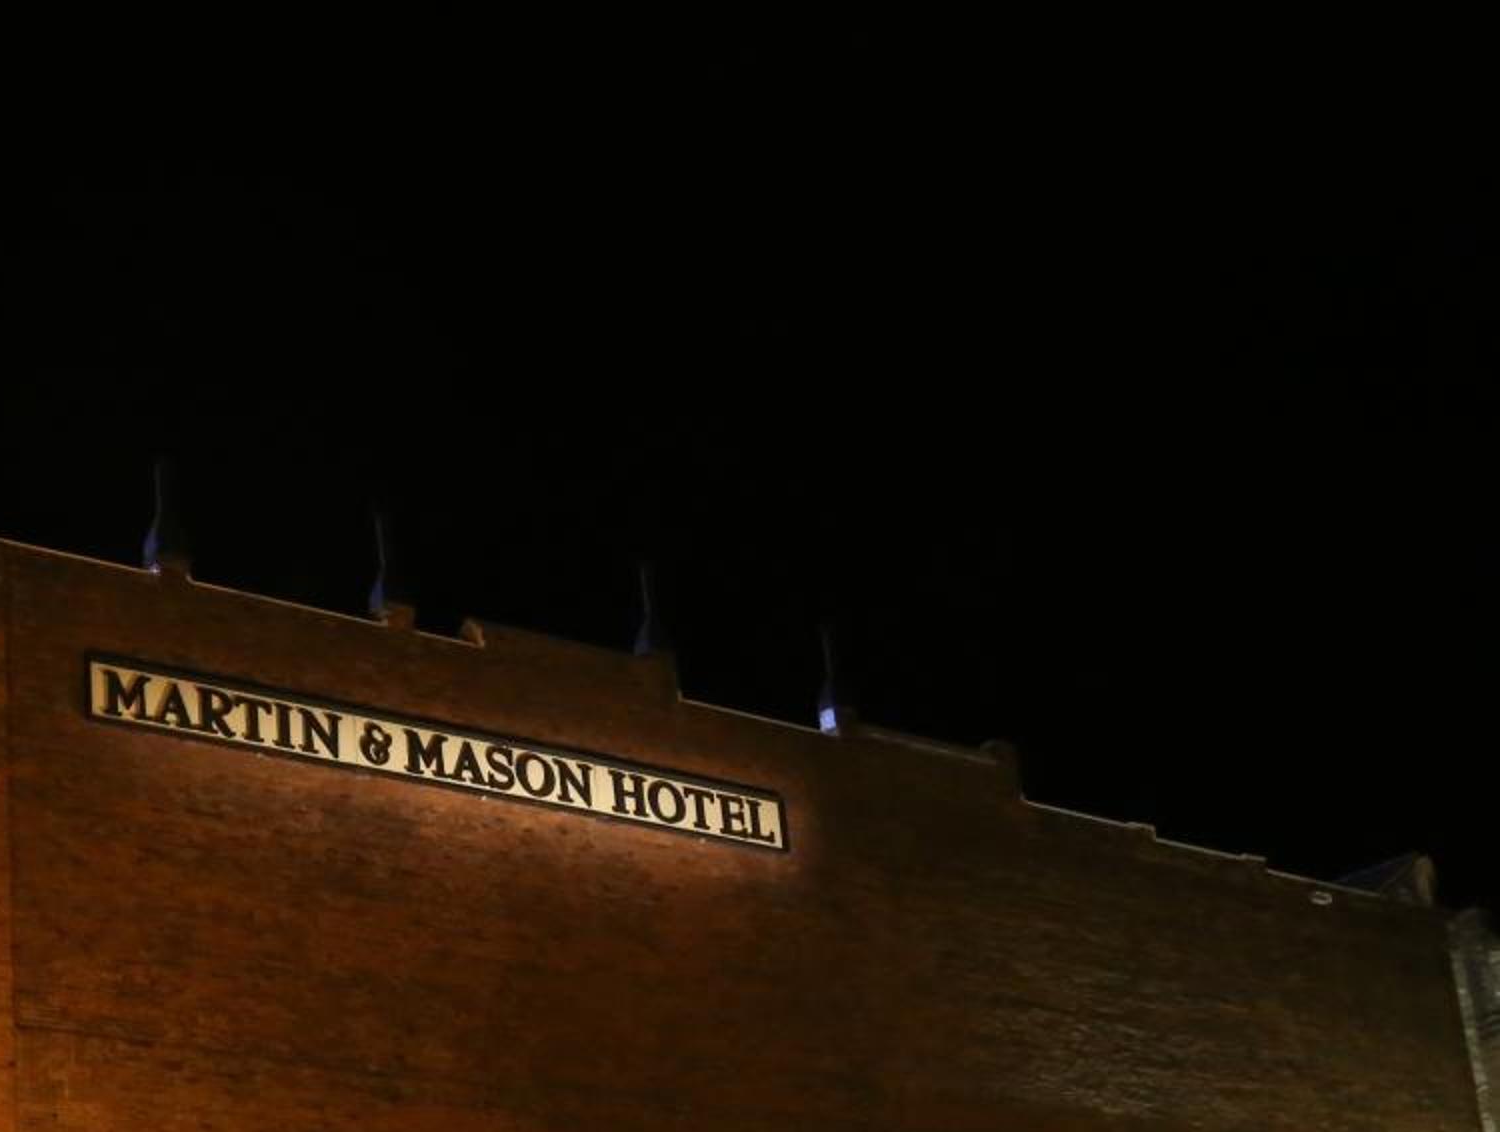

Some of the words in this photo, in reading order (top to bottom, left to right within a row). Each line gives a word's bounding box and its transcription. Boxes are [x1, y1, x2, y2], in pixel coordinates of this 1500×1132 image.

[100, 669, 343, 759] MARTIN
[359, 720, 393, 766] &
[403, 728, 593, 808] MASON
[608, 769, 776, 843] HOTEL
